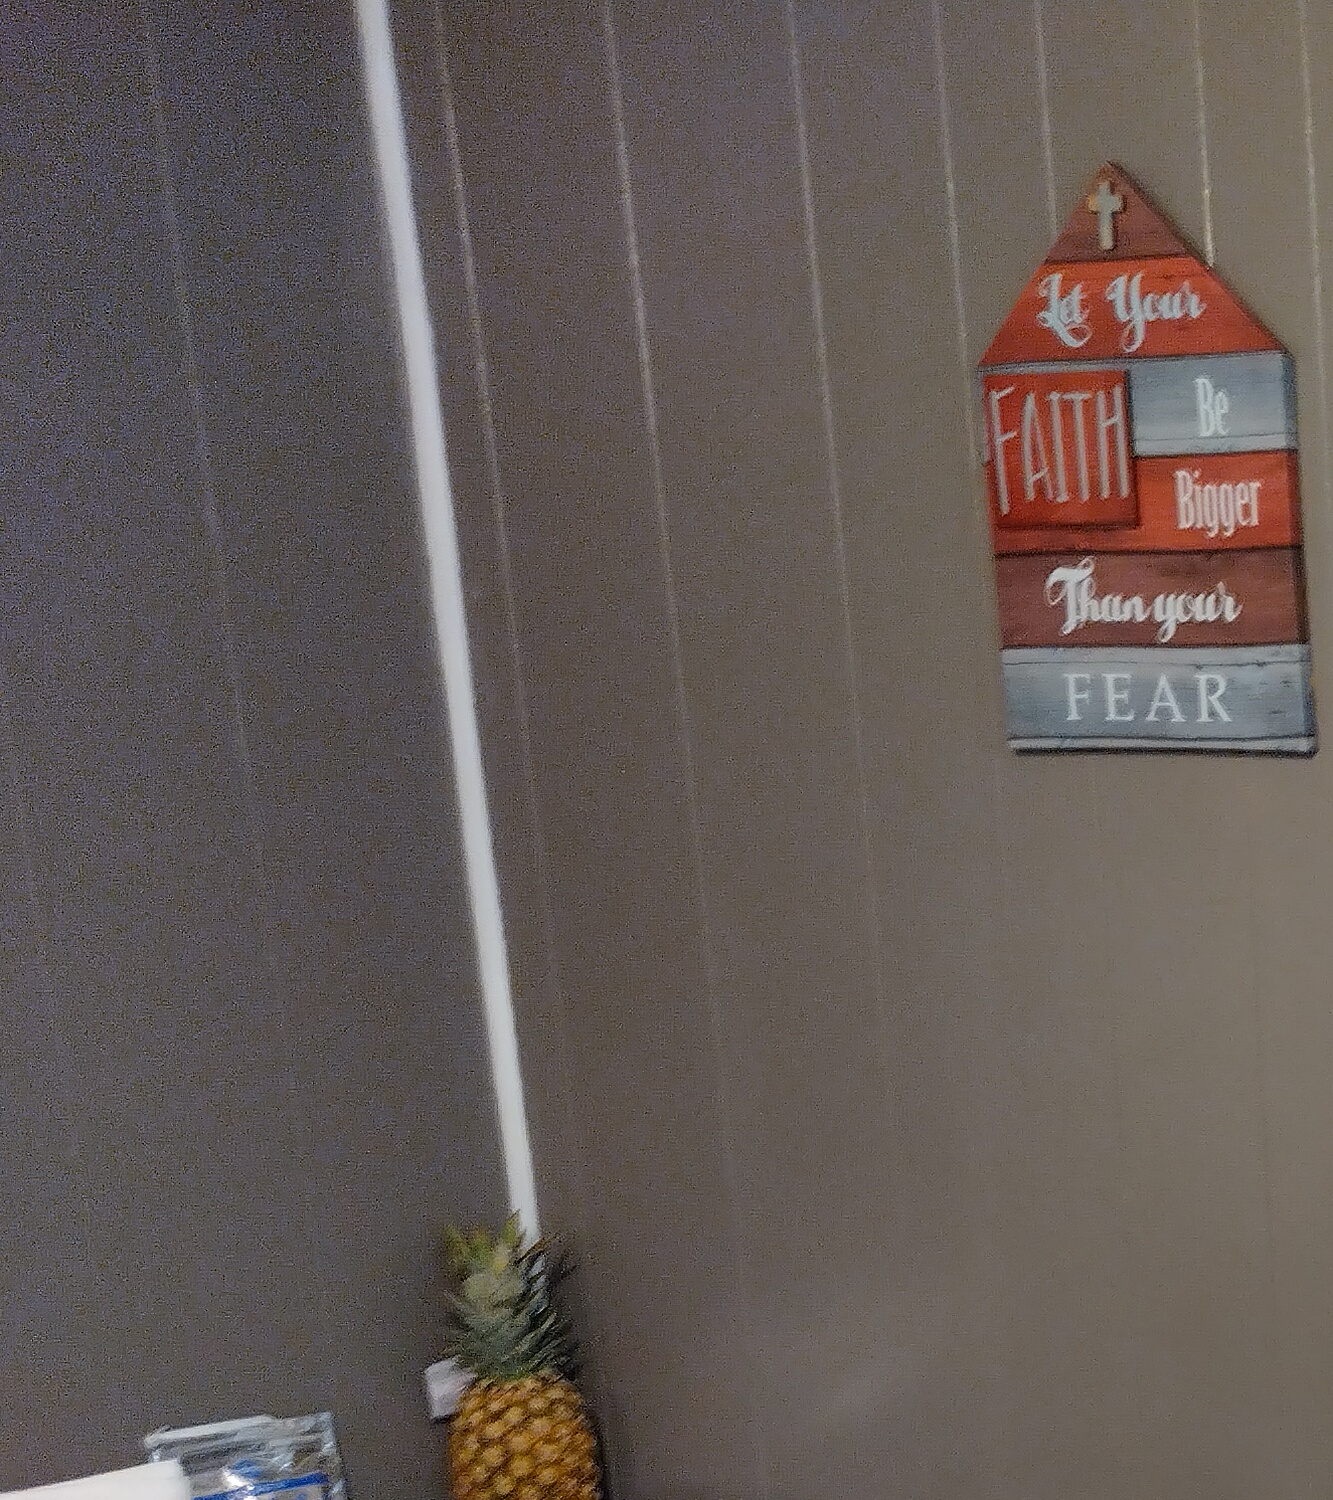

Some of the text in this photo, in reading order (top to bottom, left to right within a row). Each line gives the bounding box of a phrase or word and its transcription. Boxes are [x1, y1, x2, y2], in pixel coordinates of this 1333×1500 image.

[1036, 269, 1207, 352] Let Your
[1194, 374, 1231, 438] Be
[987, 380, 1130, 519] FAITH
[1172, 468, 1264, 540] Bigger
[1044, 556, 1244, 644] Than your
[1062, 672, 1233, 726] FEAR
